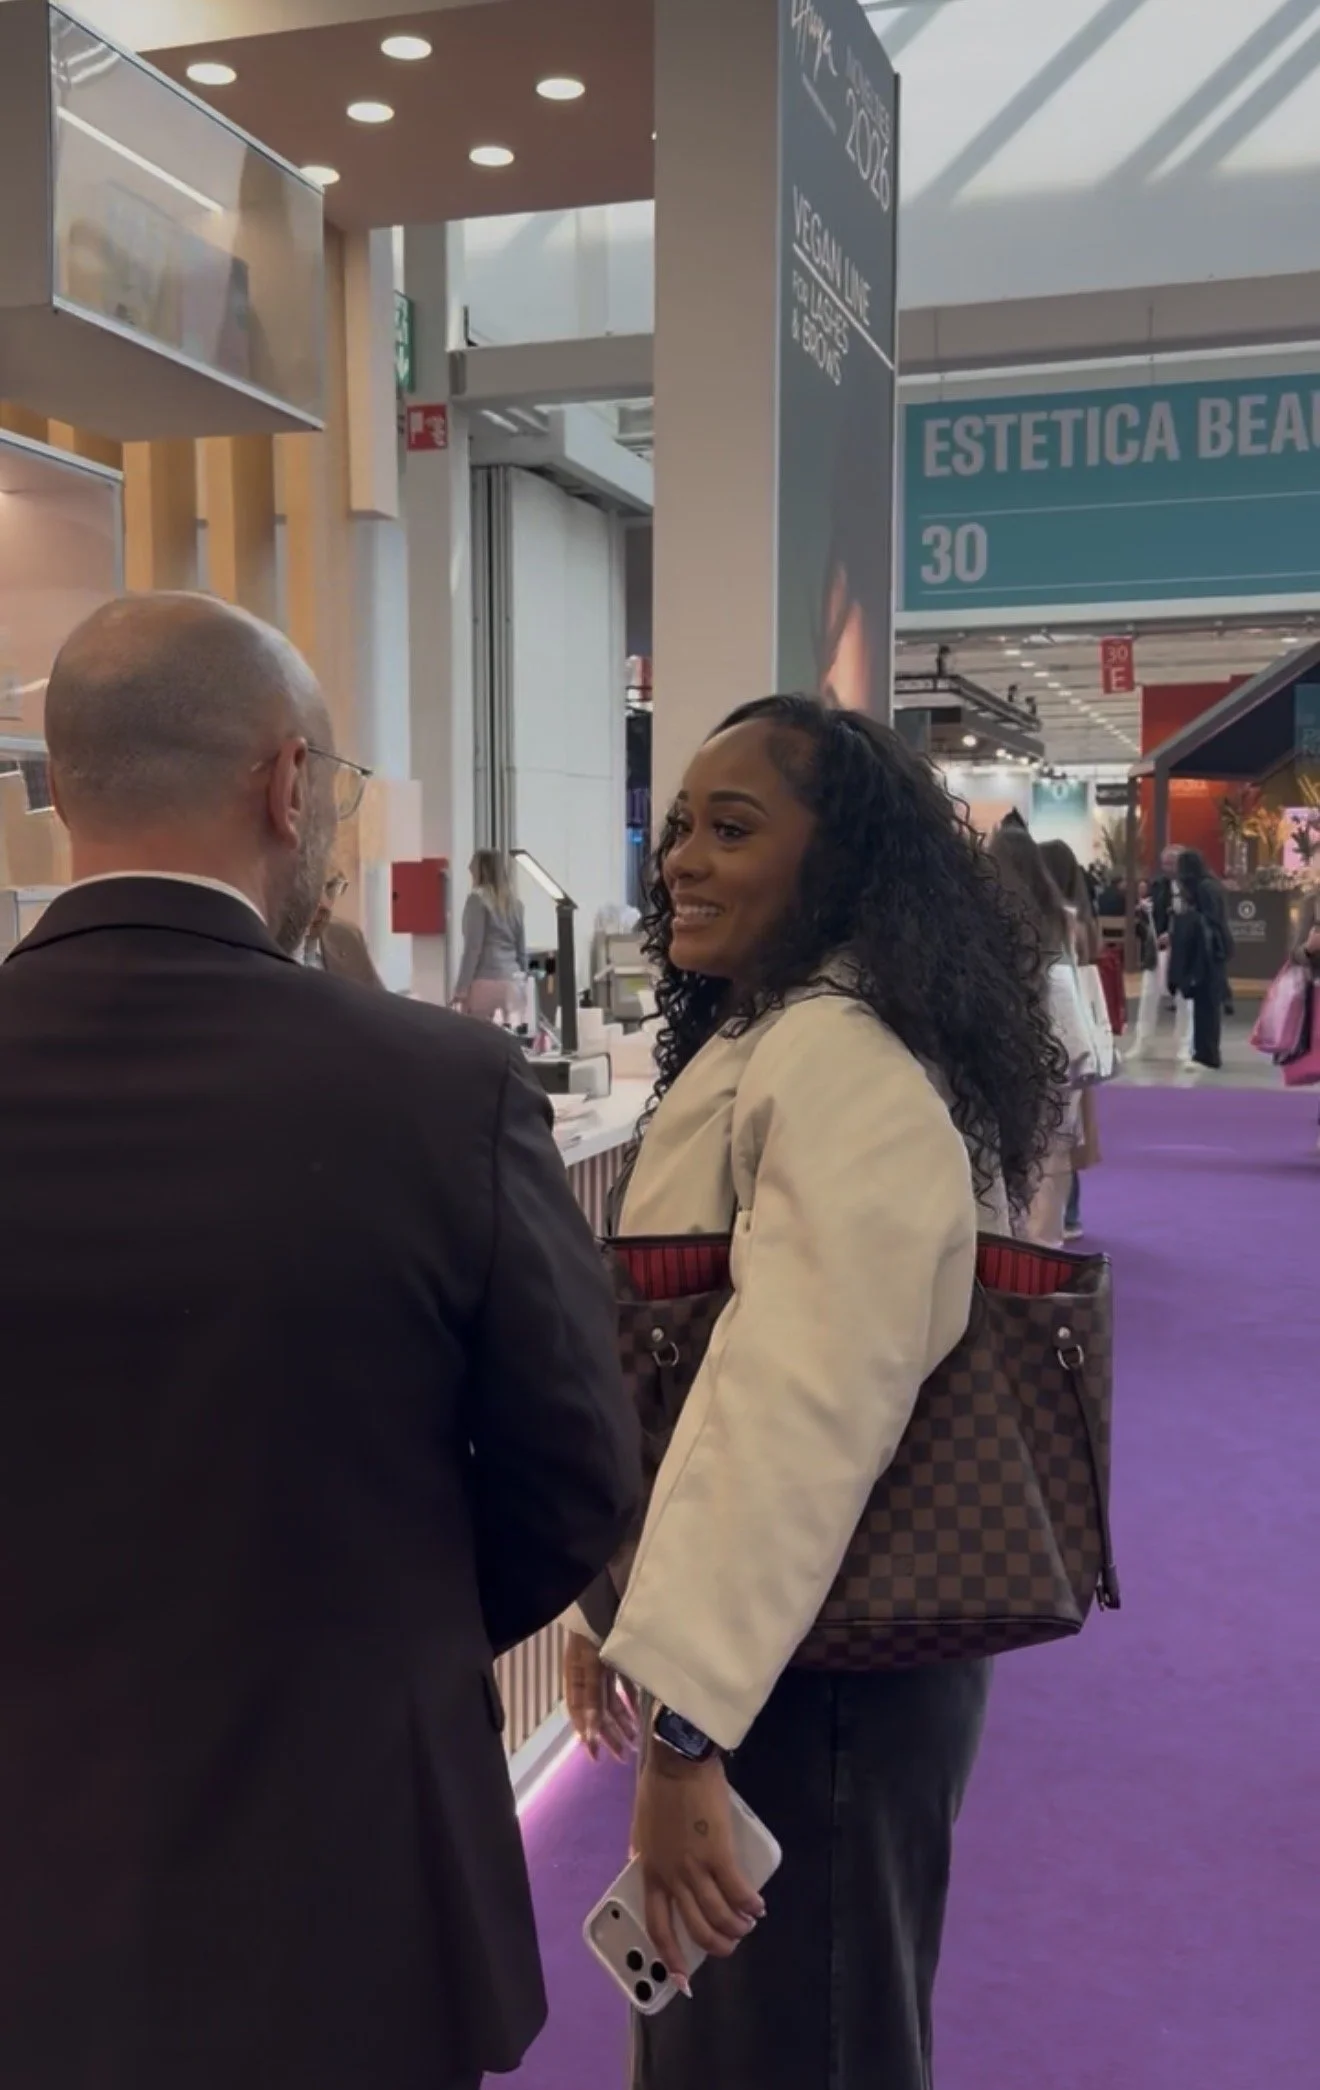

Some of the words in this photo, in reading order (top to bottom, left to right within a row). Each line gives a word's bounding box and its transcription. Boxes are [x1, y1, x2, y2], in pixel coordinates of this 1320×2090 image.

[845, 88, 890, 211] 2026
[793, 185, 842, 289] VEGAN
[844, 256, 871, 327] LINE
[791, 308, 800, 342] &
[802, 315, 842, 386] BROWS
[792, 270, 809, 307] FOR
[811, 281, 850, 355] LASHES
[923, 402, 1181, 478] ESTETICA
[920, 522, 988, 584] 30
[1107, 645, 1129, 664] 30
[1111, 667, 1128, 691] E
